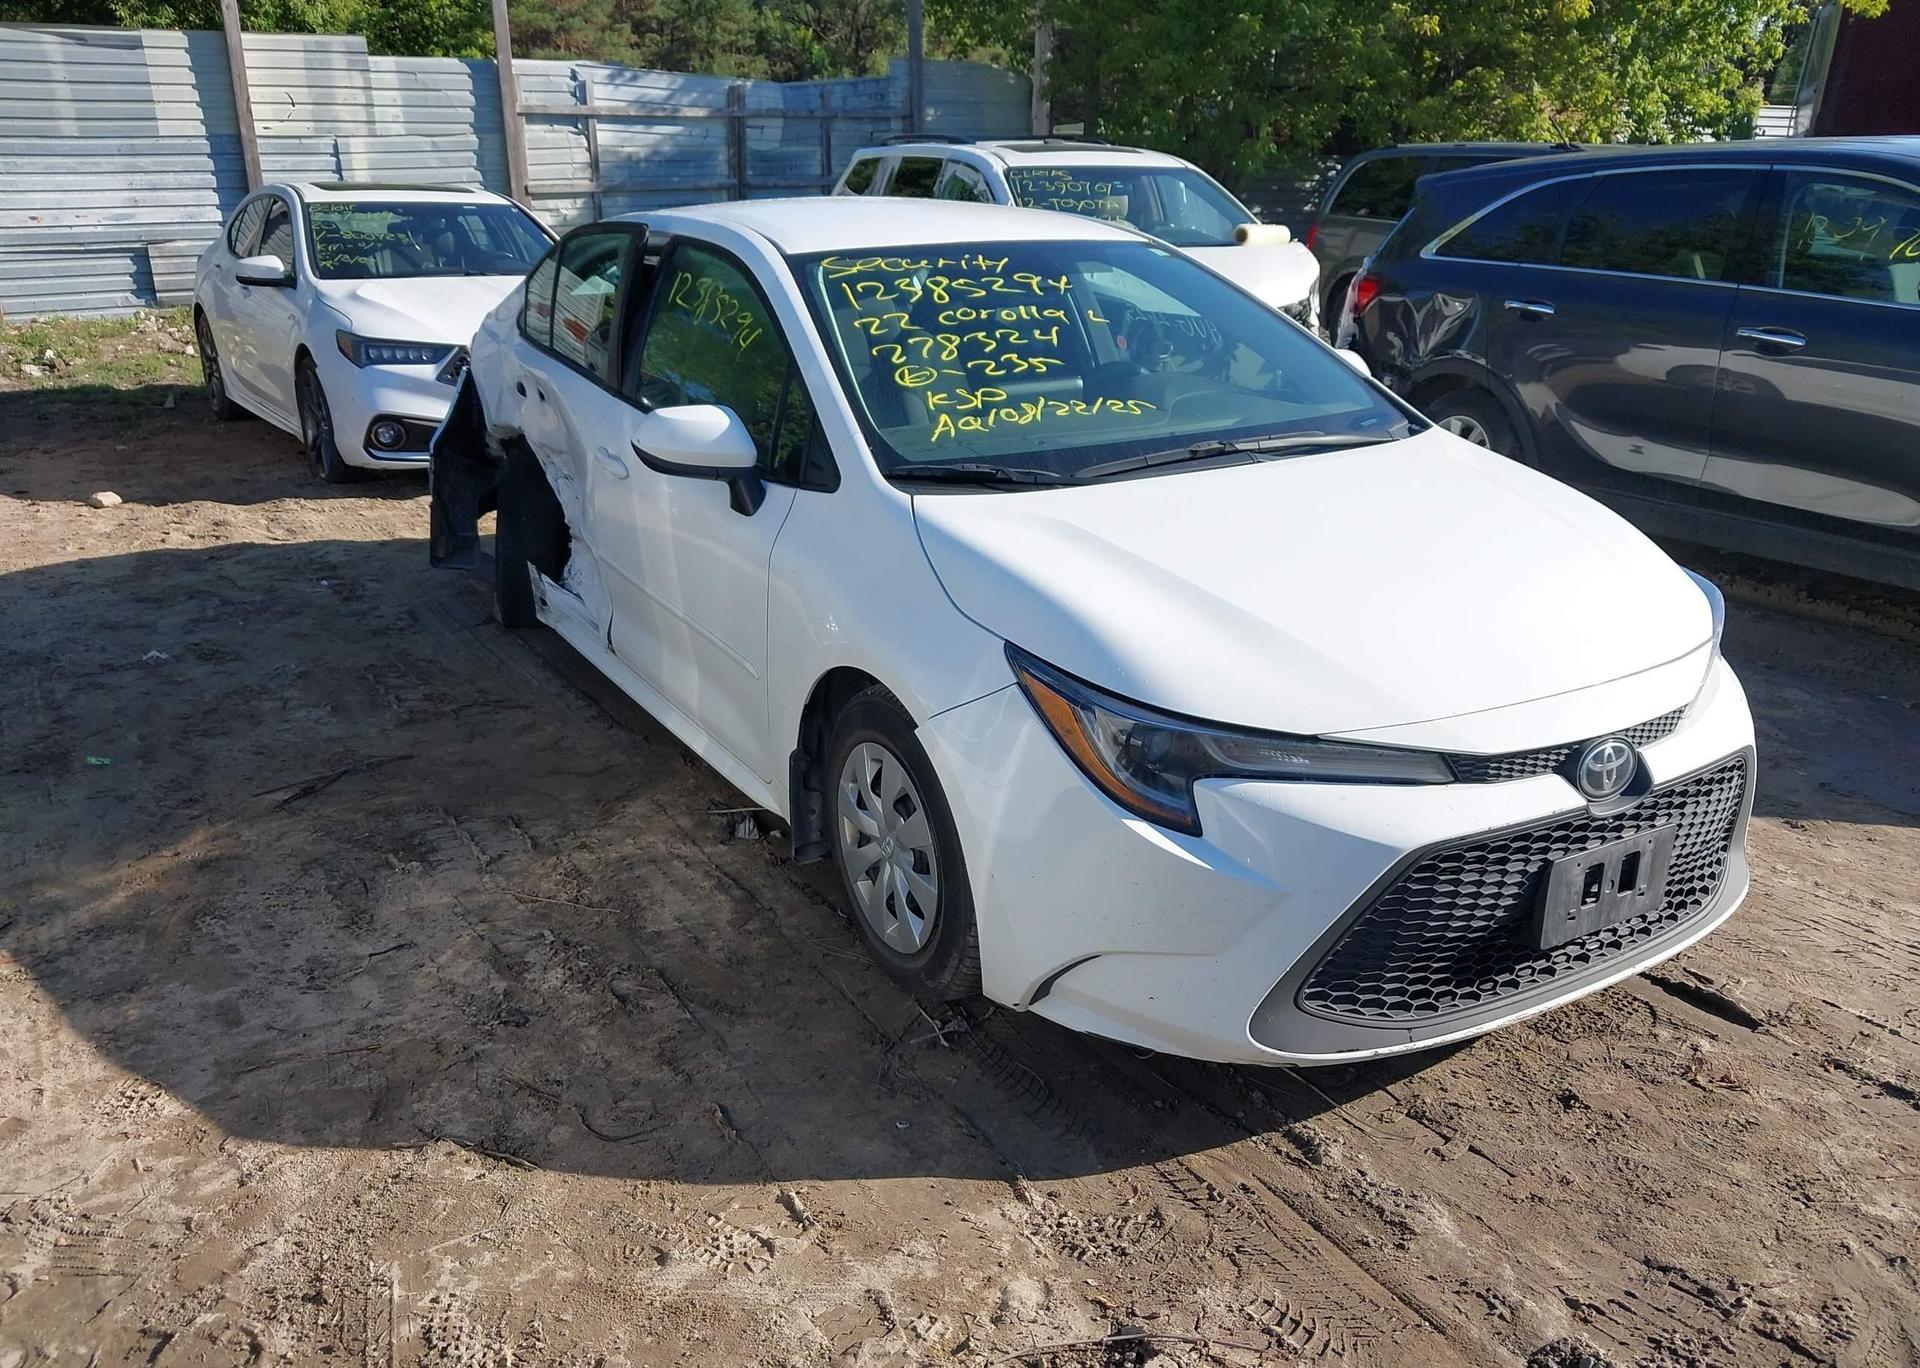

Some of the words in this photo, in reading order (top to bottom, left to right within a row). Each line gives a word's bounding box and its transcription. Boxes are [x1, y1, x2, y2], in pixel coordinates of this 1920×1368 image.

[820, 253, 1010, 279] Security
[841, 272, 1074, 311] 12385294
[854, 312, 924, 335] 22
[872, 326, 1060, 364] 278324
